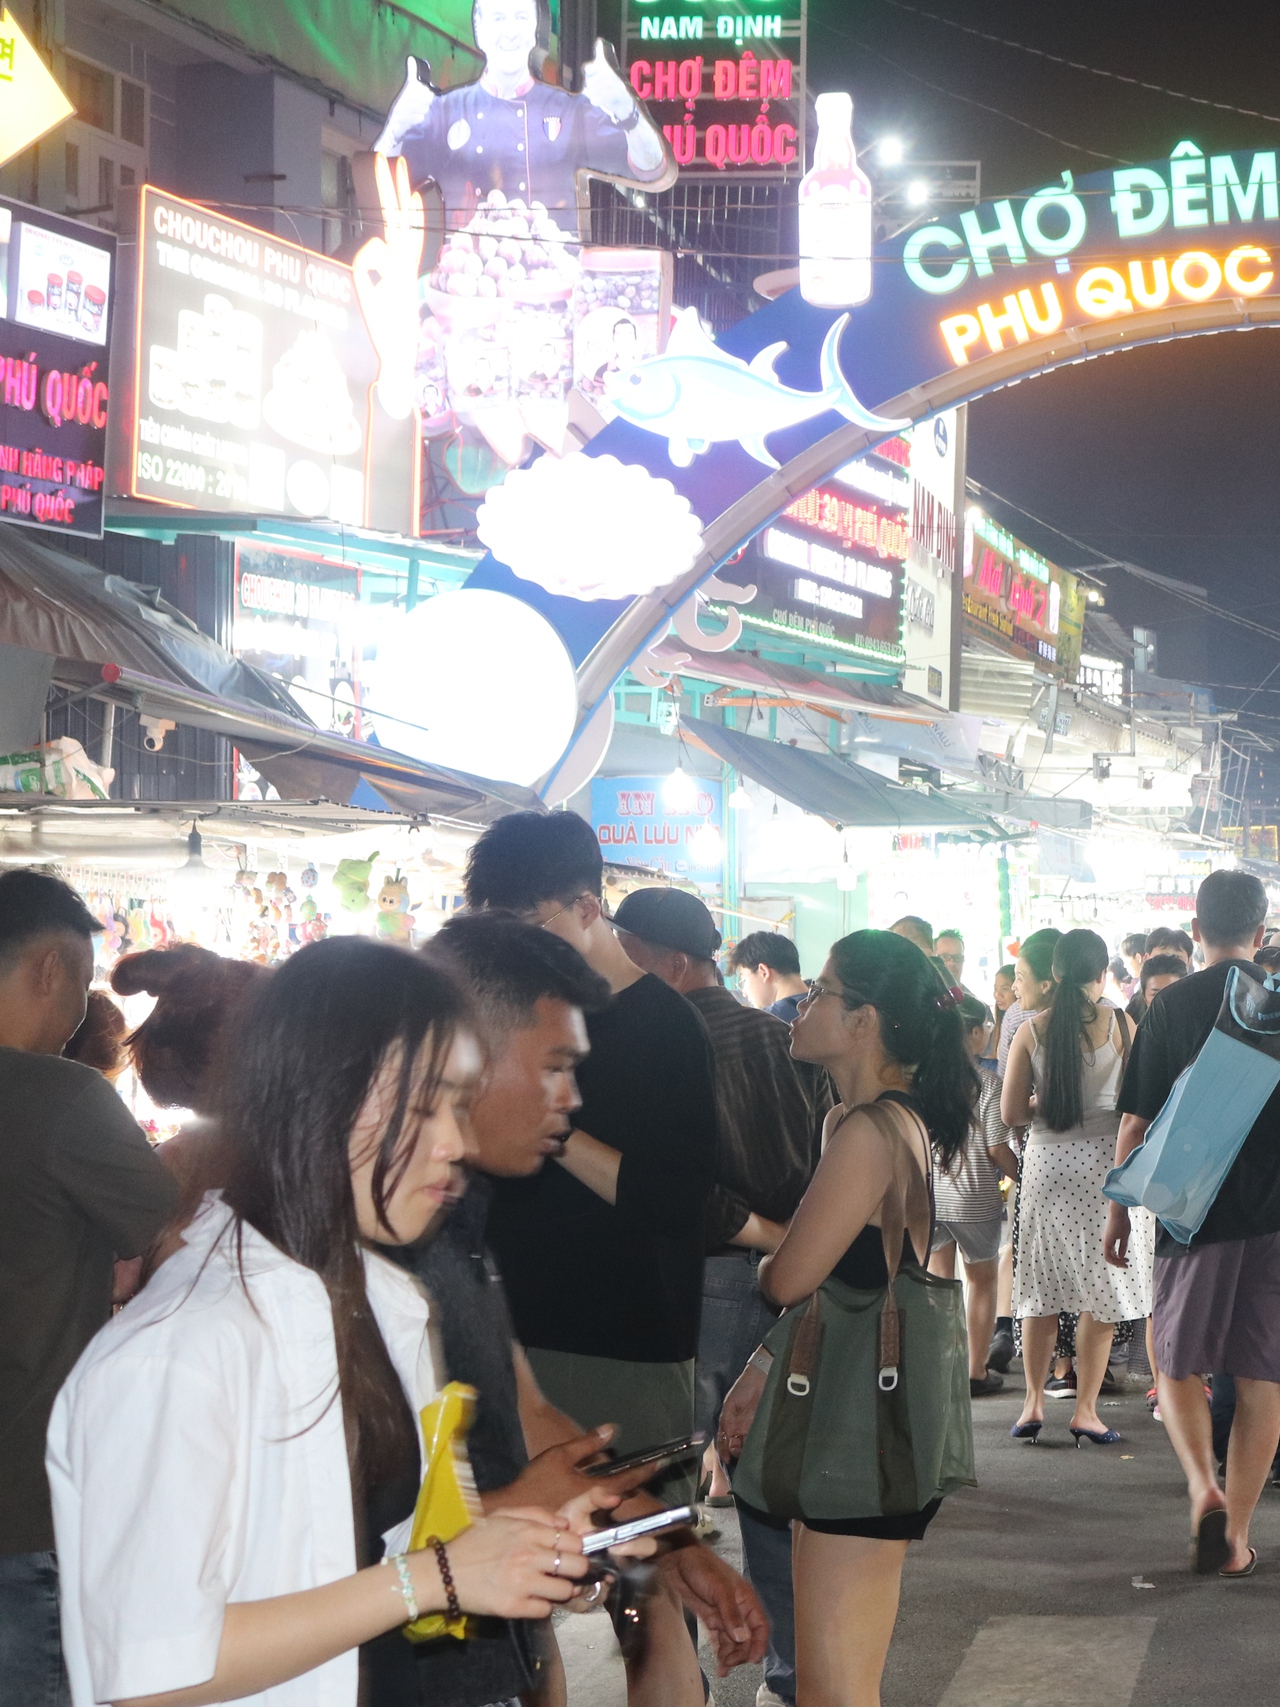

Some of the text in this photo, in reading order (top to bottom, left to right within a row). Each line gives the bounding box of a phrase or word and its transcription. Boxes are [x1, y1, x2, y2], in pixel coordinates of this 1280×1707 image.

[640, 15, 782, 46] NAM ĐỊNH
[630, 50, 792, 110] CHỢ ĐÊM
[704, 103, 796, 170] QUỐC
[903, 169, 1087, 294] CHỢ
[1110, 140, 1280, 238] ĐÊM
[154, 205, 351, 303] CHOUCHOU PHU QUOC
[939, 281, 1063, 366] PHU
[1075, 245, 1274, 318] QUOC
[46, 361, 109, 429] QUỐC
[22, 447, 63, 483] HÃNG
[66, 459, 104, 490] PHÁP
[138, 452, 164, 482] ISO
[165, 458, 206, 492] 22000
[1, 483, 75, 523] PHÚ QUỐC
[912, 478, 935, 556] NAM
[241, 572, 296, 616] CHOUCHOU
[617, 791, 655, 817] IN
[597, 820, 639, 845] QUÀ
[643, 820, 680, 845] LƯU
